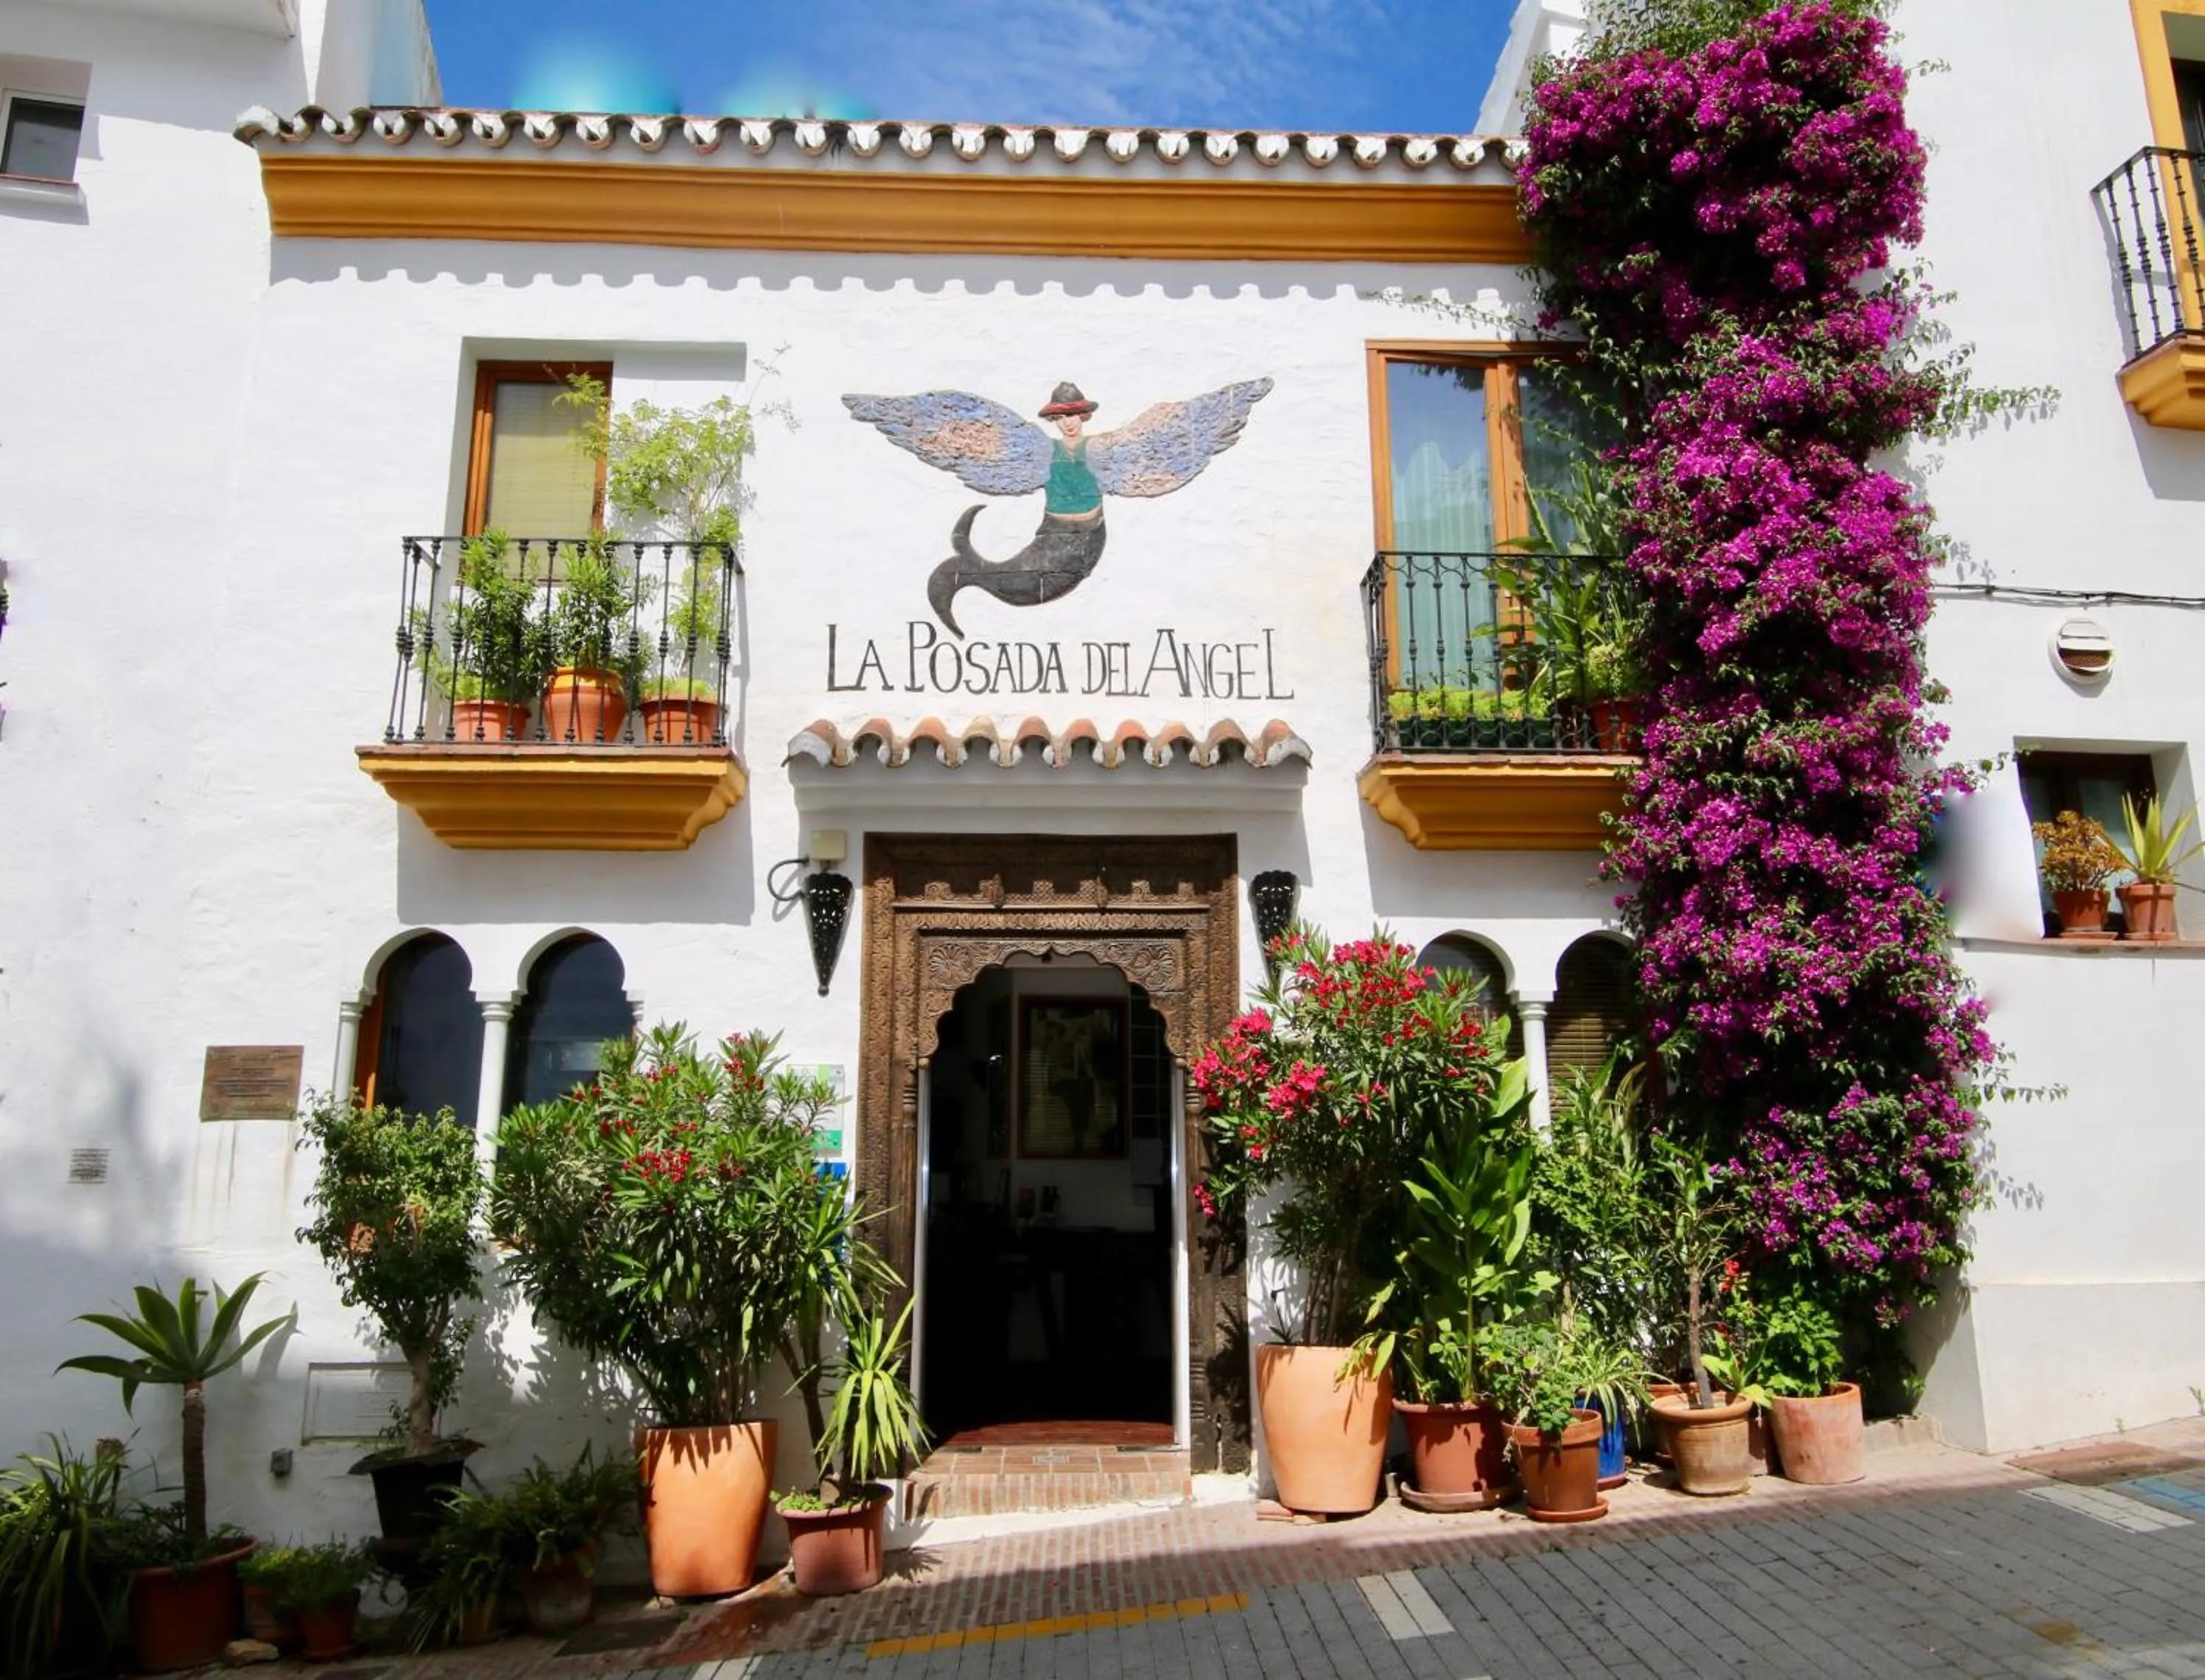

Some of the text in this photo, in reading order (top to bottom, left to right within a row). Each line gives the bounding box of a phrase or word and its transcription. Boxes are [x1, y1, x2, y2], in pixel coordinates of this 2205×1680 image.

[827, 621, 1294, 700] LA POSADA DEL ANGEL
